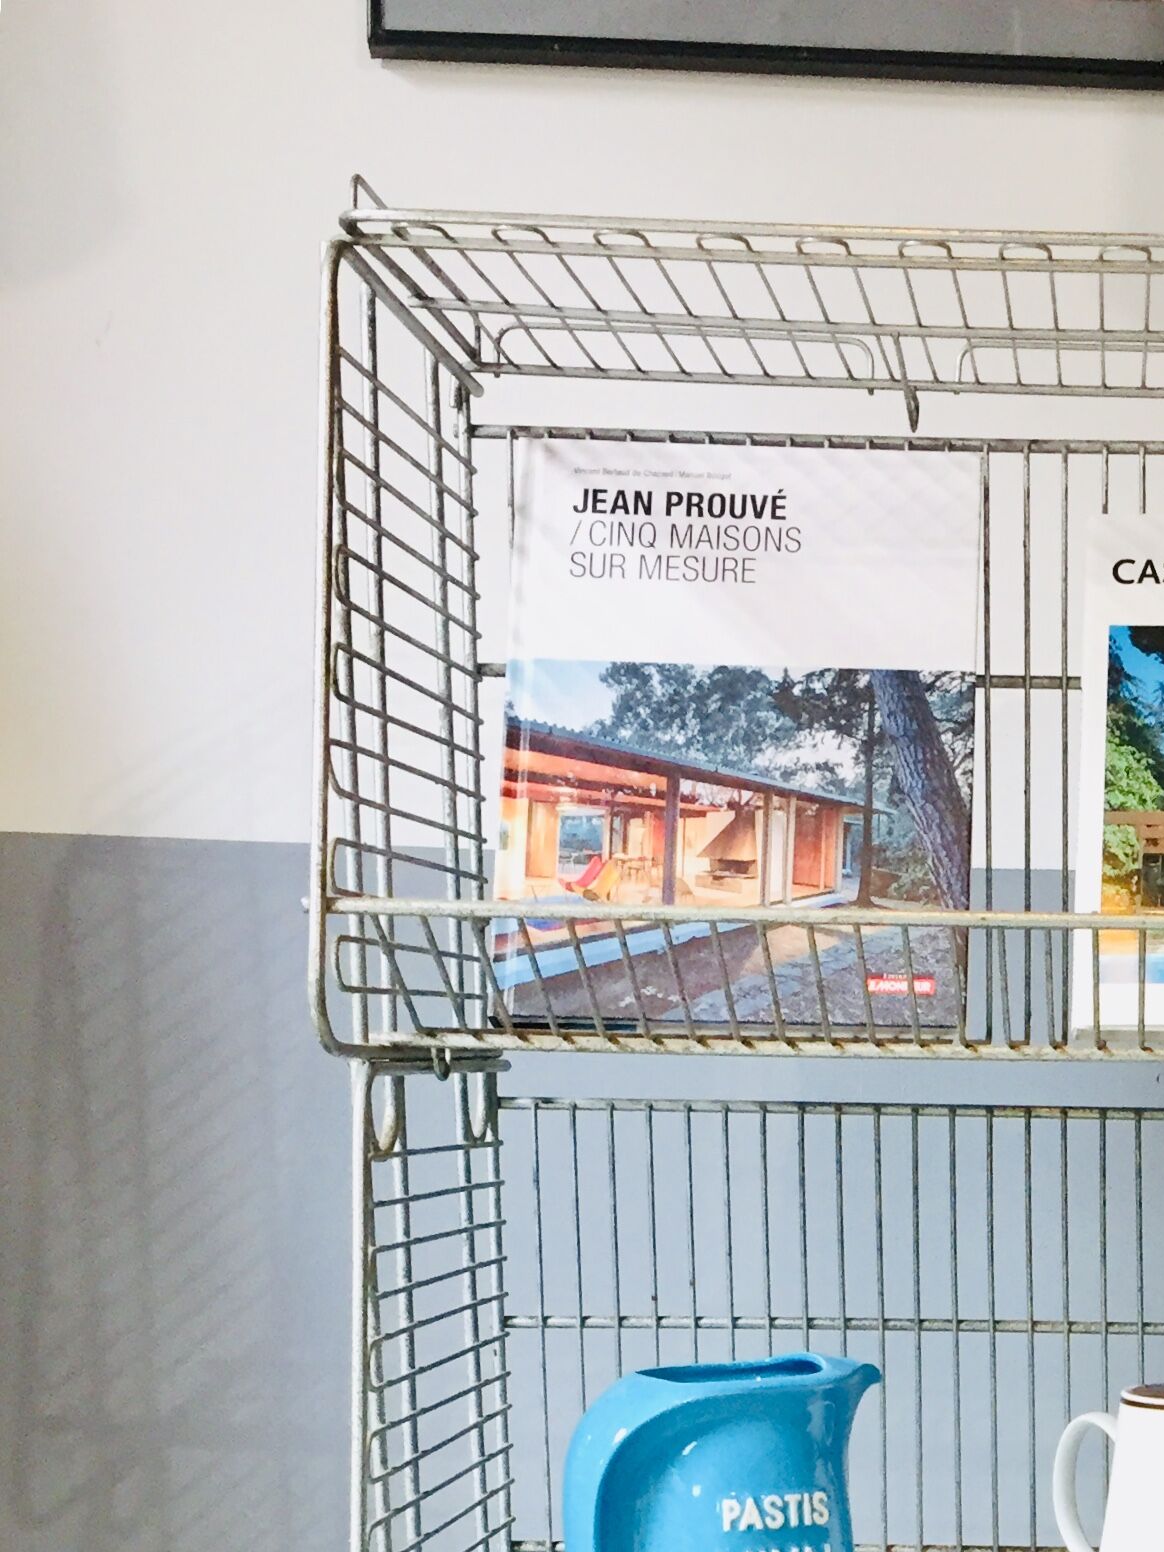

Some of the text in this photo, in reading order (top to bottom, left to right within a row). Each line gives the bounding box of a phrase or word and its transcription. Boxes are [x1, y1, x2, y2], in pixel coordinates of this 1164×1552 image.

[573, 488, 787, 520] JEAN PROUVÉ
[670, 523, 801, 553] MAISONS
[569, 551, 757, 584] SUR MESURE
[721, 1490, 830, 1532] PASTIS
